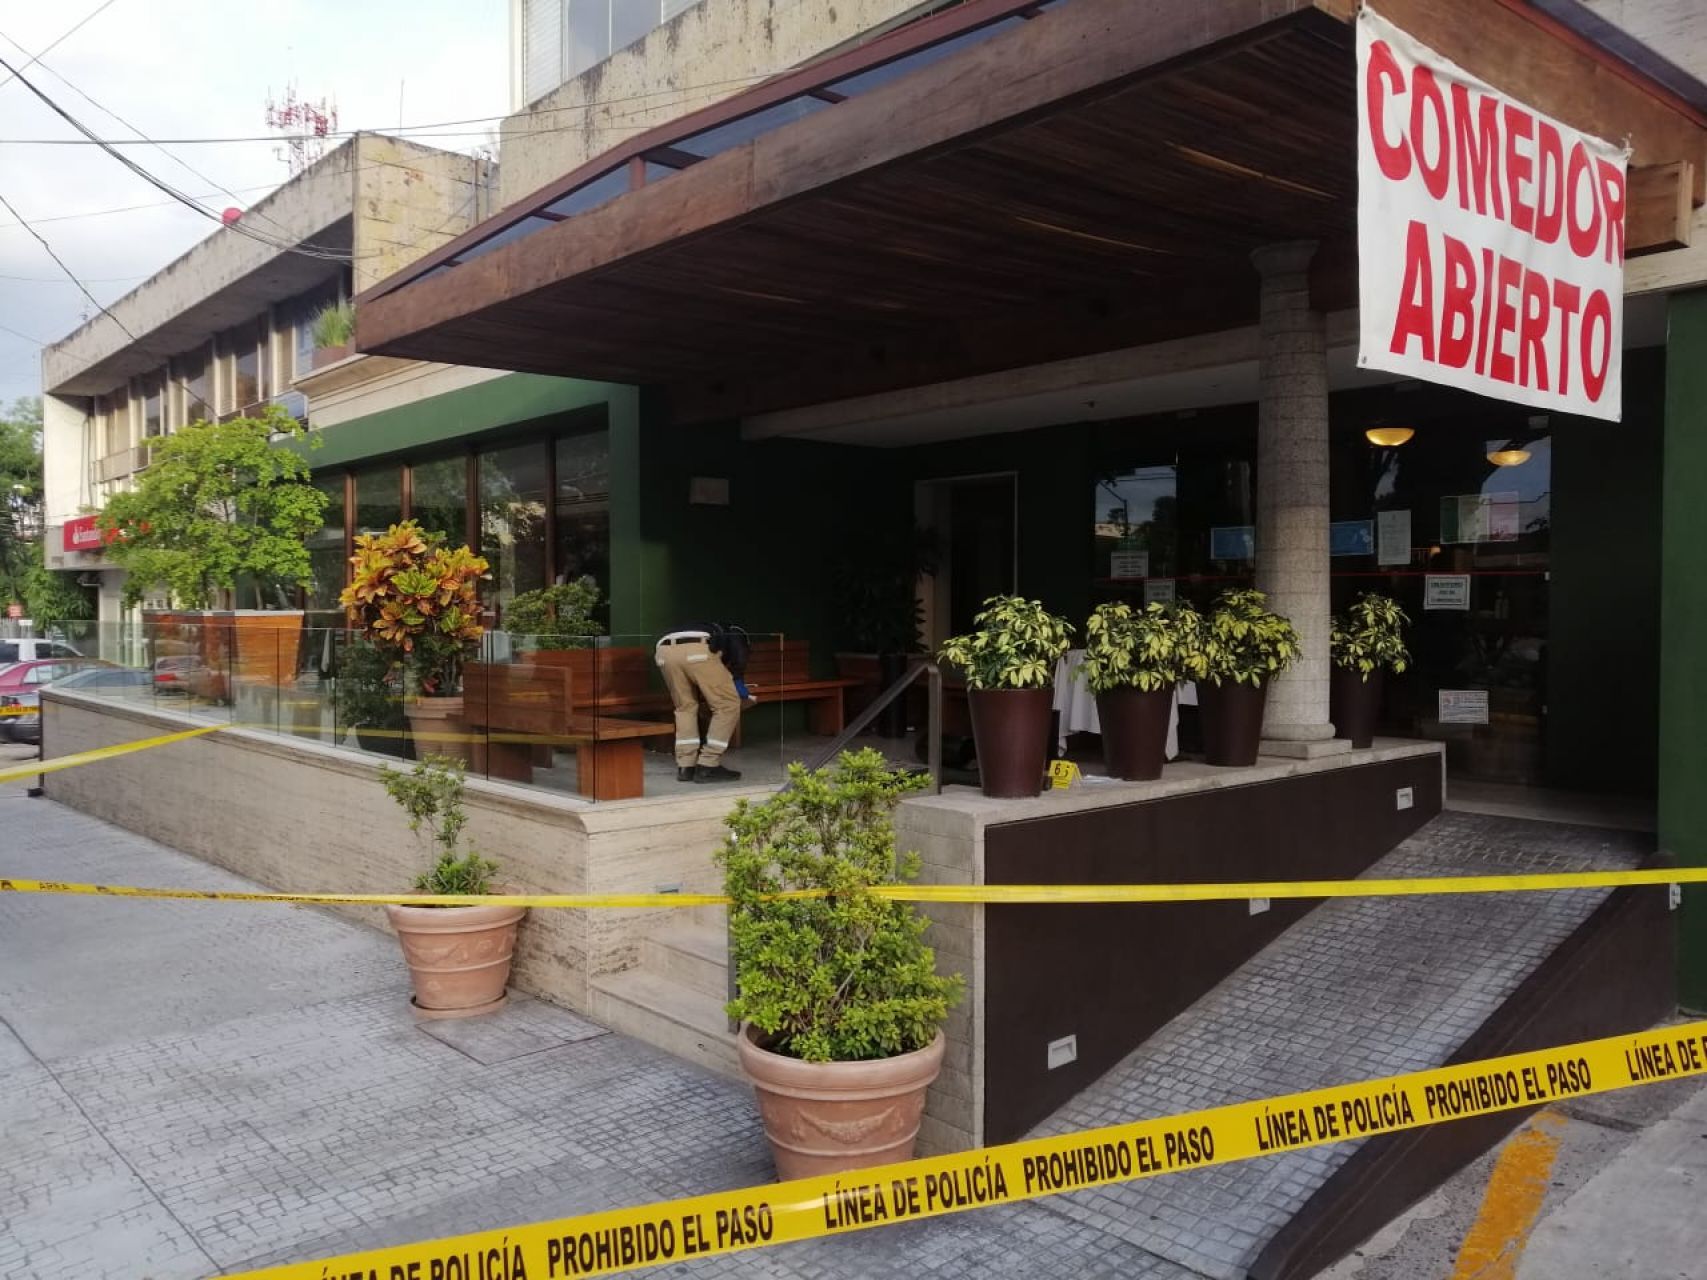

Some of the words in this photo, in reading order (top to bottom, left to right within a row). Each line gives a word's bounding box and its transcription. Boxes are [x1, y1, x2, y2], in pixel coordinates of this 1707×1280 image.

[1366, 39, 1626, 268] COMEDOR
[1389, 220, 1612, 402] ABIERTO
[547, 1219, 675, 1278] PROHIBIDO
[682, 1204, 711, 1254] EL
[715, 1192, 773, 1249] PASO
[823, 1180, 888, 1229] LÍNEA
[892, 1177, 920, 1217] DE
[925, 1155, 1008, 1211] POLICÍA
[1023, 1141, 1131, 1193] PROHIBIDO
[1136, 1136, 1162, 1173] EL
[1164, 1126, 1214, 1168] PASO
[1255, 1106, 1312, 1150] LÍNEA
[1313, 1104, 1340, 1140] DE
[1341, 1083, 1415, 1135] POLICÍA
[1424, 1070, 1519, 1119] PROHIBIDO
[1521, 1066, 1547, 1101] EL
[1546, 1057, 1592, 1096] PASO
[1625, 1040, 1678, 1080] LÍNEA
[1676, 1038, 1702, 1072] DE
